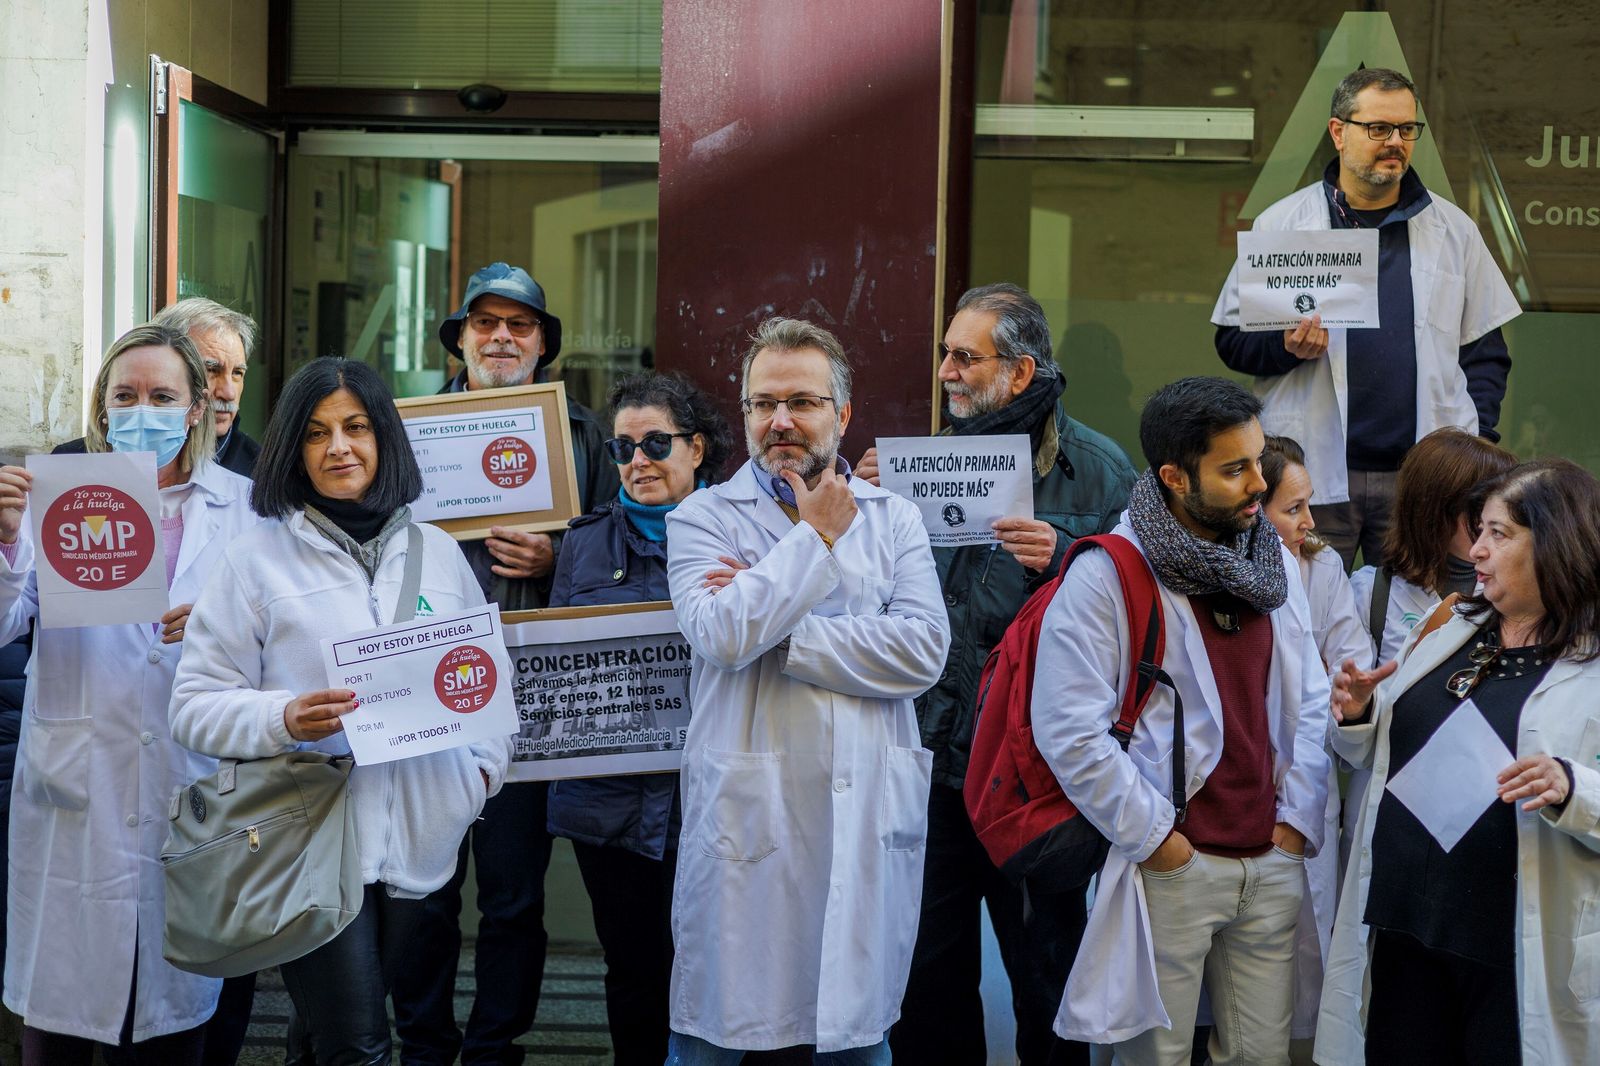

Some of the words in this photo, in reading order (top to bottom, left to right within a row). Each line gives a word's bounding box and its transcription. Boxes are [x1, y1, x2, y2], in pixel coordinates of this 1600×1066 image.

[1524, 126, 1600, 168] Ju
[1266, 250, 1313, 268] ATENCIÓN
[1315, 252, 1362, 266] PRIMARIA
[1266, 276, 1281, 289] NO
[1284, 275, 1314, 288] PUEDE
[419, 427, 437, 435] HOY
[440, 425, 466, 434] ESTOY
[482, 420, 517, 430] HUELGA
[439, 464, 462, 472] TUYOS
[490, 453, 527, 470] SMP
[909, 452, 962, 472] ATENCIÓN
[964, 455, 1016, 472] PRIMARIA
[498, 477, 512, 485] 20
[515, 475, 523, 484] E
[74, 490, 89, 499] Yo
[92, 491, 112, 500] voy
[913, 482, 928, 498] NO
[931, 481, 964, 497] PUEDE
[73, 500, 83, 510] la
[87, 499, 125, 511] huelga
[464, 497, 491, 505] TODOS
[58, 521, 135, 551] SMP
[113, 550, 137, 558] PRIMARIA
[76, 566, 104, 582] 20
[112, 565, 126, 580] E
[358, 642, 381, 655] HOY
[384, 636, 415, 649] ESTOY
[417, 632, 431, 643] DE
[433, 623, 473, 640] HUELGA
[516, 642, 692, 673] CONCENTRACIÓN
[344, 676, 363, 686] POR
[365, 673, 372, 681] TI
[443, 666, 486, 691] SMP
[517, 676, 573, 690] Salvemos
[577, 673, 587, 685] la
[590, 669, 642, 684] Atención
[366, 692, 383, 704] LOS
[384, 687, 412, 700] TUYOS
[454, 699, 470, 709] 20
[474, 694, 483, 705] E
[519, 694, 535, 705] 28
[539, 693, 555, 705] de
[559, 691, 602, 702] enero,
[606, 686, 623, 698] 12
[627, 685, 664, 697] horas
[520, 707, 582, 721] Servicios
[586, 700, 650, 716] centrales
[655, 698, 681, 710] SAS
[357, 724, 372, 732] POR
[373, 721, 384, 731] MI
[419, 723, 449, 740] TODOS
[451, 722, 462, 732] !!!
